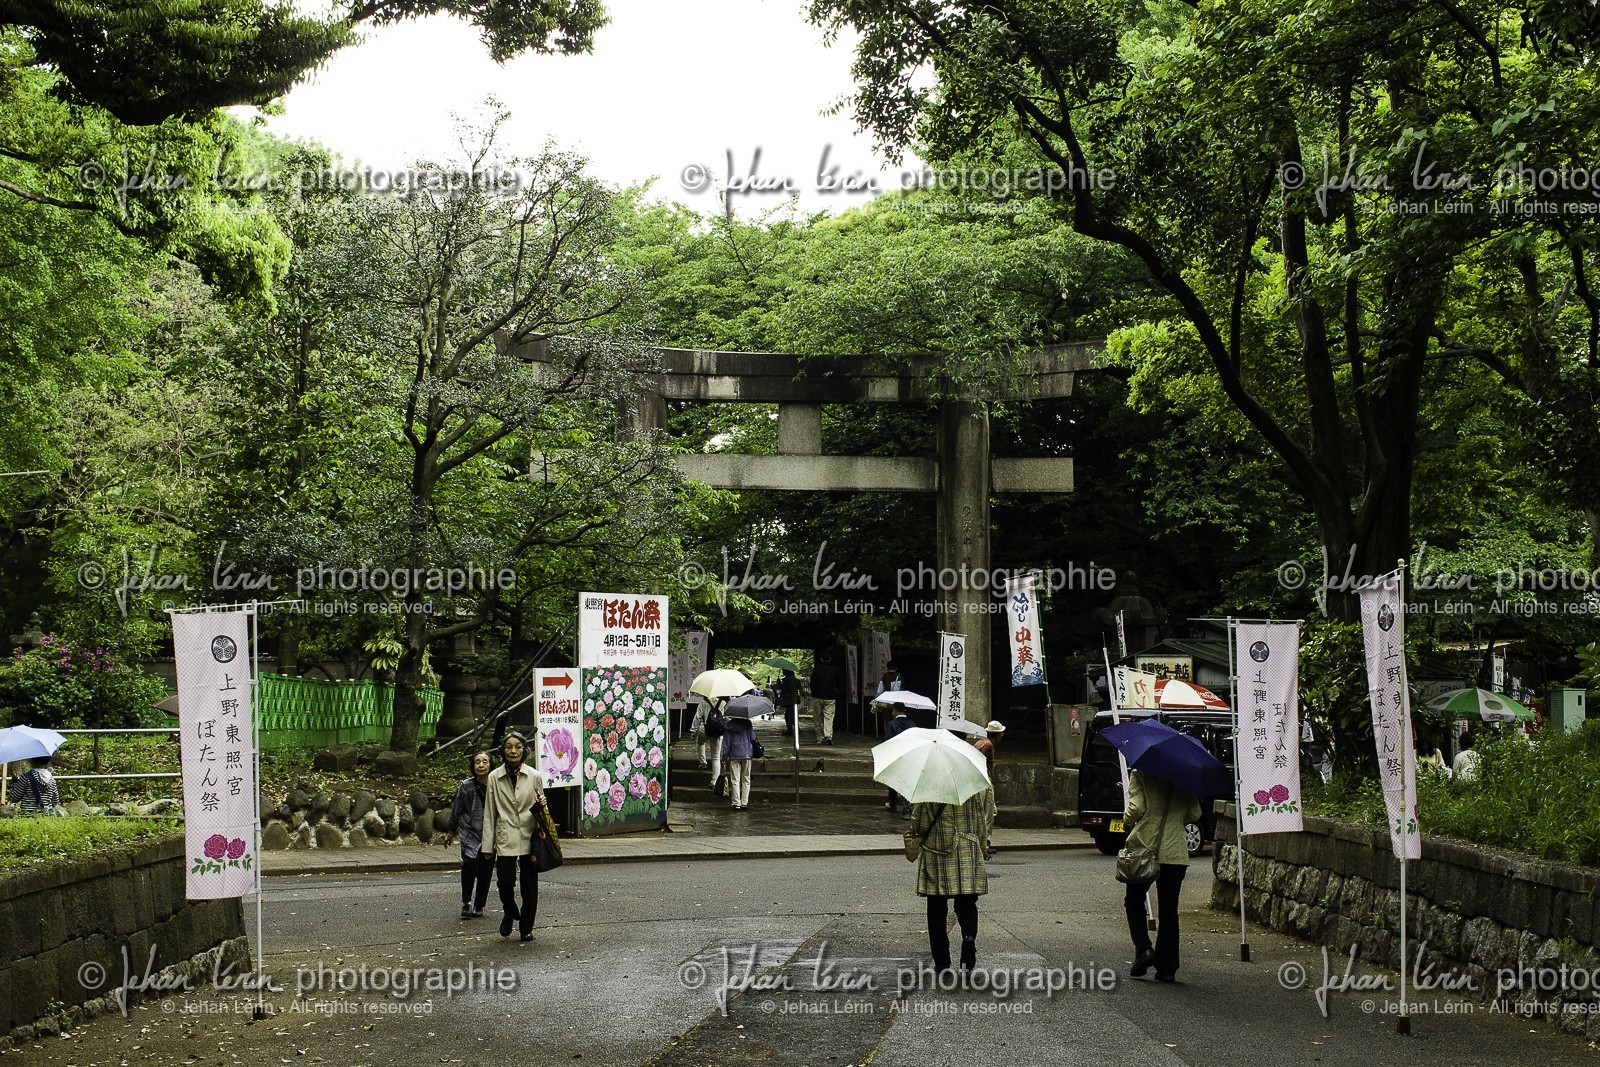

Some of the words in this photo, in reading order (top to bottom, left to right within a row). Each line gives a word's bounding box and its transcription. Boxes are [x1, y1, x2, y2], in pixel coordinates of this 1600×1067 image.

[1013, 592, 1034, 666] 冷し中華
[197, 718, 221, 813] ぼたん祭
[219, 673, 243, 797] 上野東照宮
